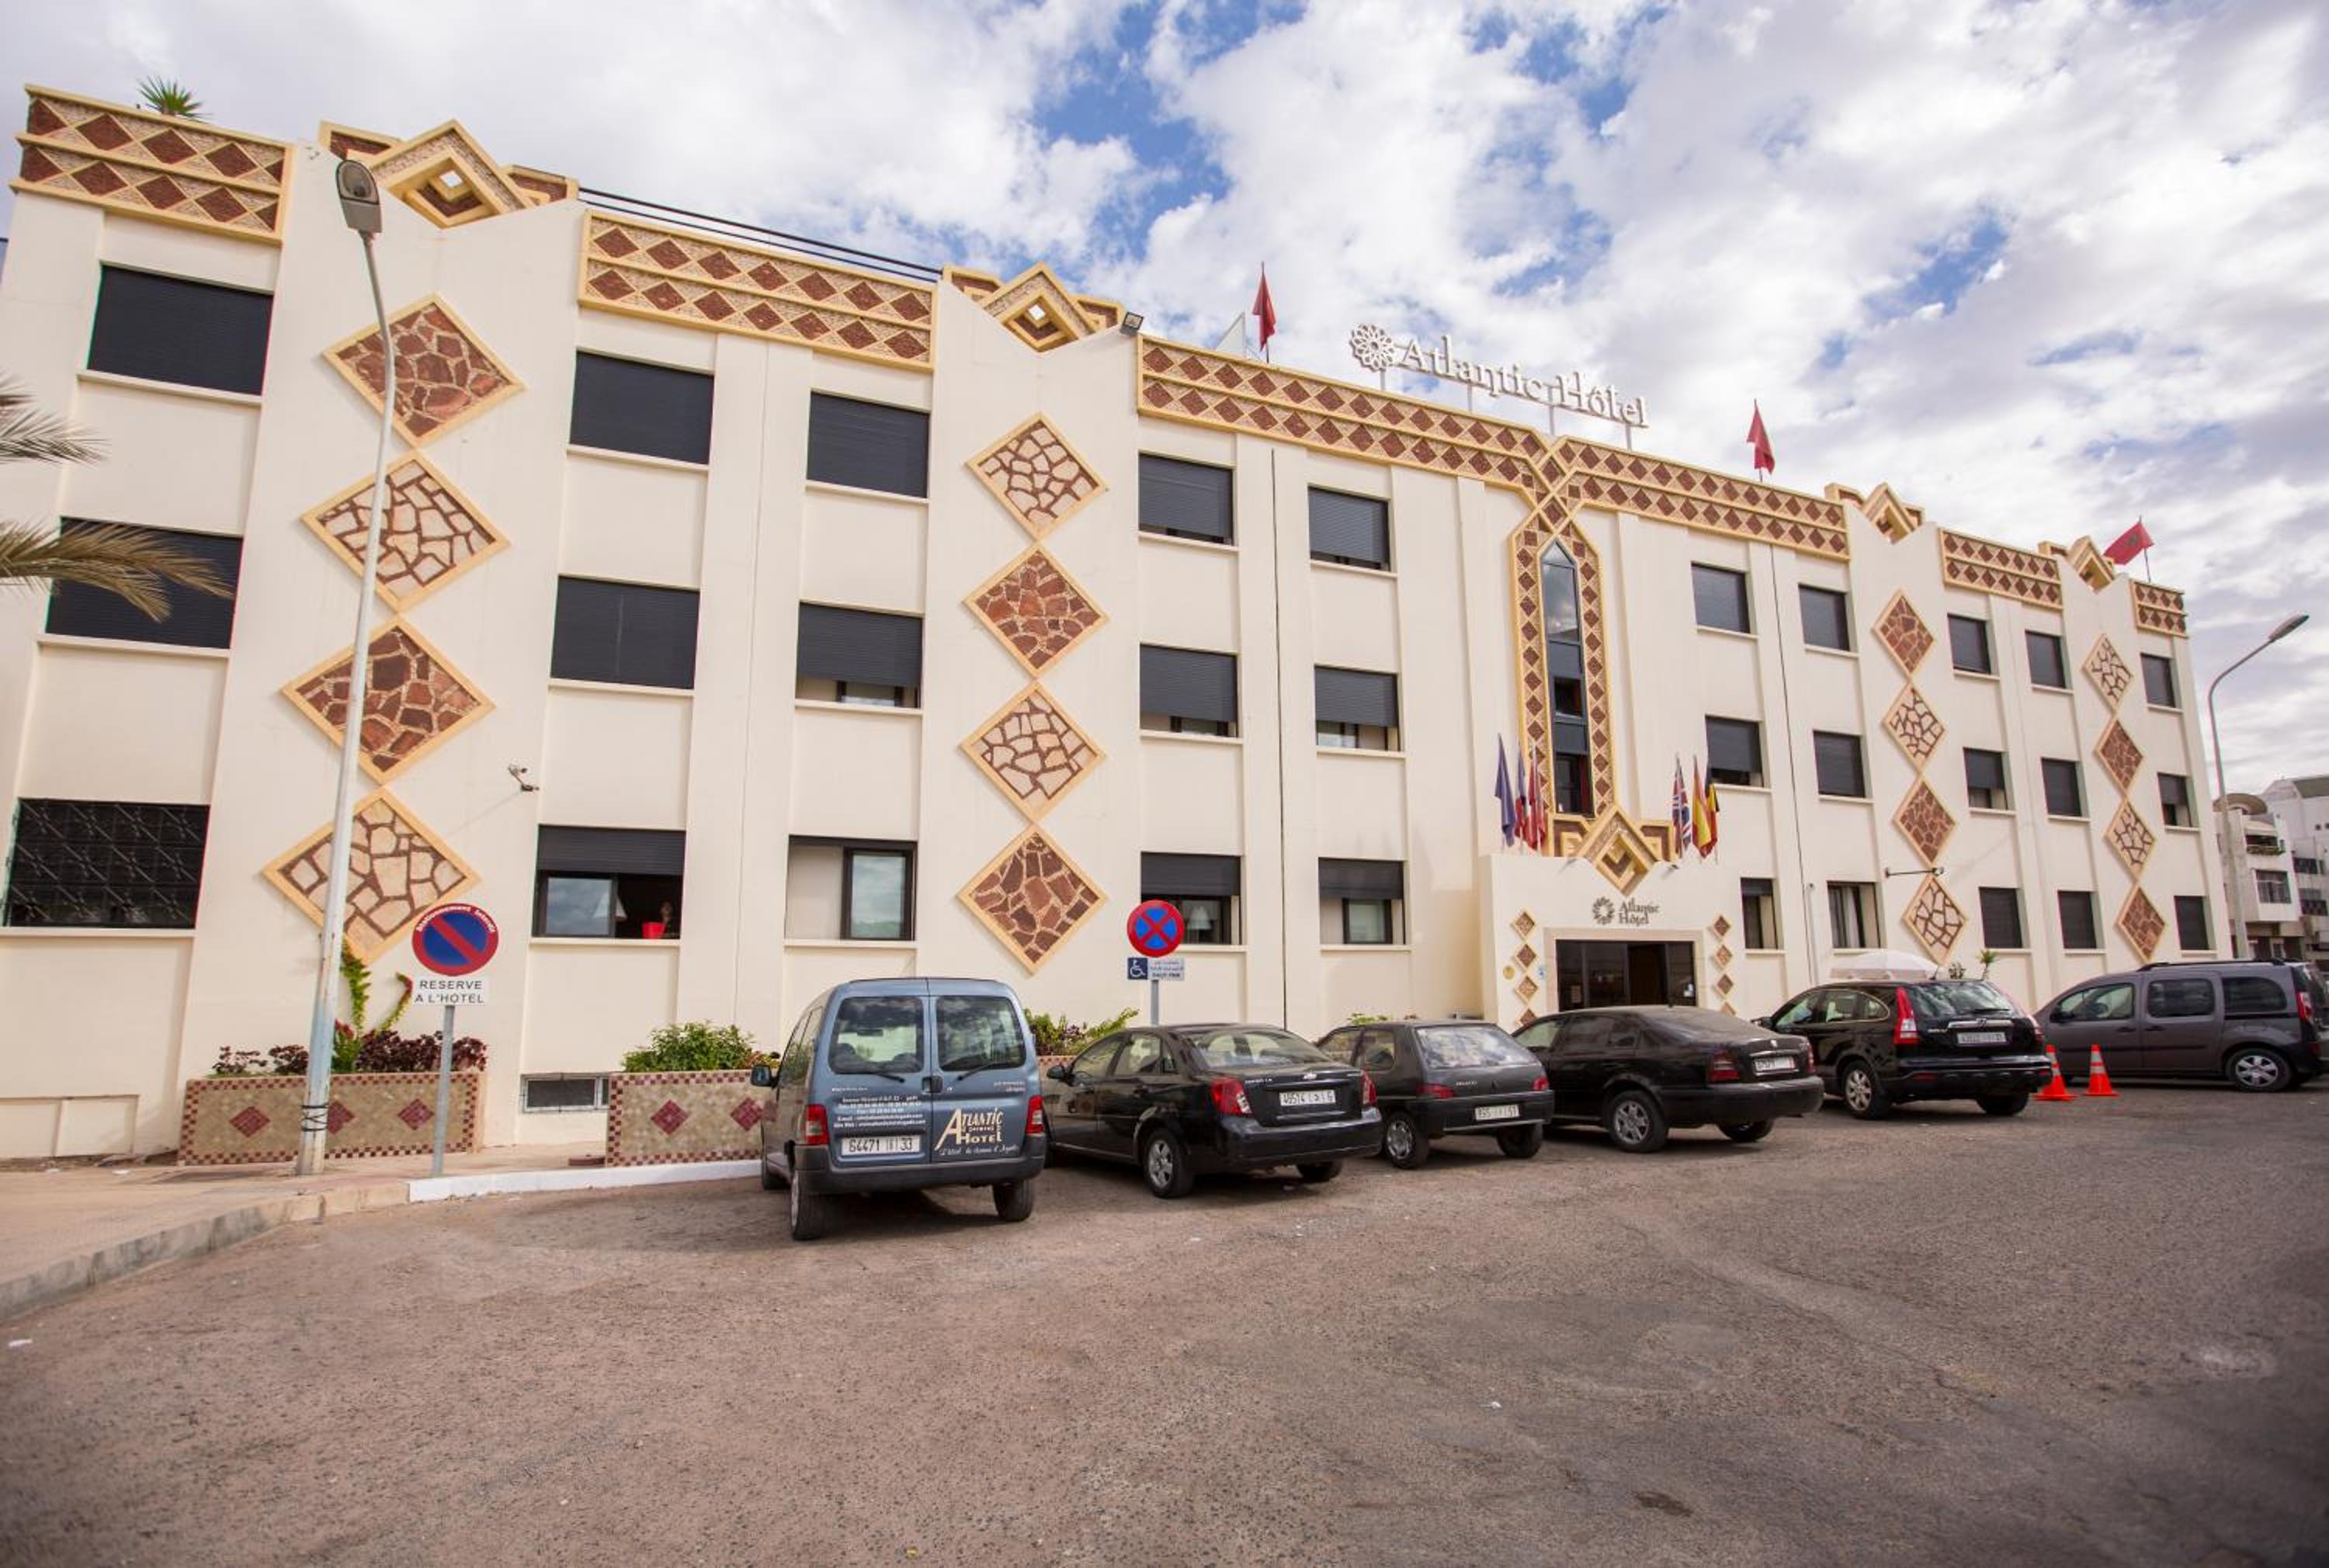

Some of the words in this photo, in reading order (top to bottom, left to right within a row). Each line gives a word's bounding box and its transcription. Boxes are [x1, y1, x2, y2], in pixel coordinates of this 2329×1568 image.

[1401, 335, 1543, 401] Atlantic
[1557, 372, 1650, 428] Hôtel
[1618, 897, 1660, 914] Atlantic
[419, 980, 482, 990] RESERVE
[414, 994, 424, 1004] A
[849, 1138, 880, 1153] 64471
[900, 1137, 912, 1151] 33
